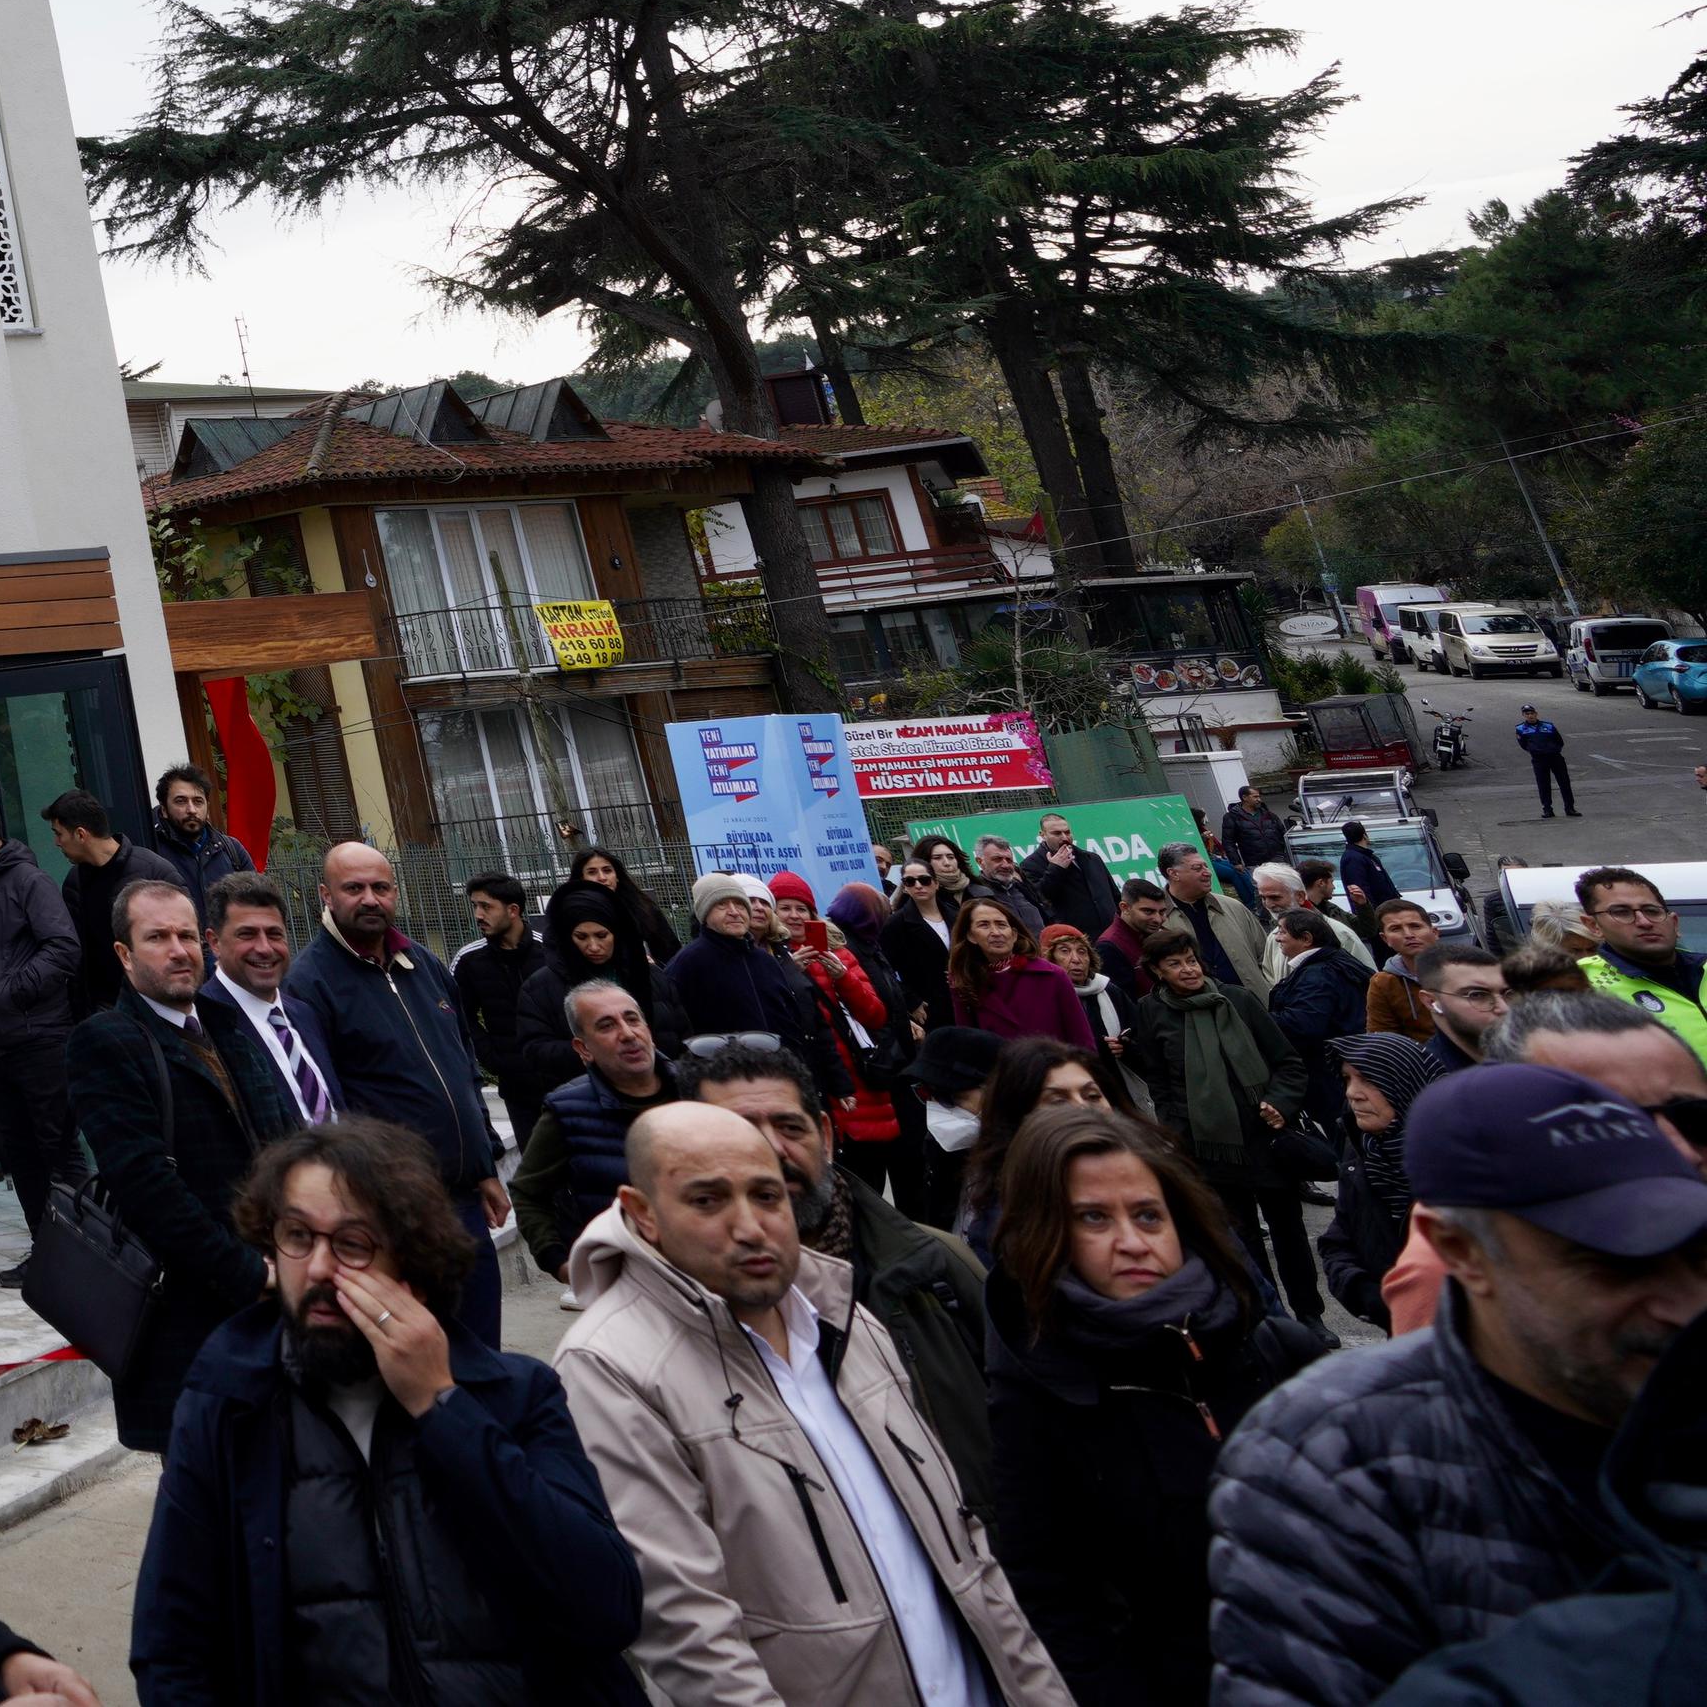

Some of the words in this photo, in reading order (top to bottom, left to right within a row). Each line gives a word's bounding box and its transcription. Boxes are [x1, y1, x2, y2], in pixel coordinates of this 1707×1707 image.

[537, 604, 586, 624] KAPTAN
[559, 639, 586, 651] 418
[589, 638, 605, 649] 60
[608, 638, 622, 649] 88
[564, 653, 592, 666] 349
[595, 652, 608, 663] 18
[611, 652, 622, 662] 00
[845, 729, 875, 742] Güzel
[879, 728, 893, 739] Bir
[896, 724, 933, 739] NİZAM
[704, 746, 757, 760] YATIRIMLAR
[849, 743, 879, 757] estek
[881, 742, 922, 756] Sizden
[924, 739, 968, 753] Hizmet
[971, 737, 1012, 750] Bizden
[853, 761, 877, 773] İZAM
[879, 757, 936, 771] MAHALLESİ
[937, 756, 978, 768] MUHTAR
[980, 755, 1010, 765] ADAYI
[869, 769, 943, 790] HÜSEYİN
[948, 769, 993, 788] ALUÇ
[713, 781, 757, 794] ATILIMLAR
[726, 829, 774, 844] BÜYÜKADA
[764, 847, 776, 859] VE
